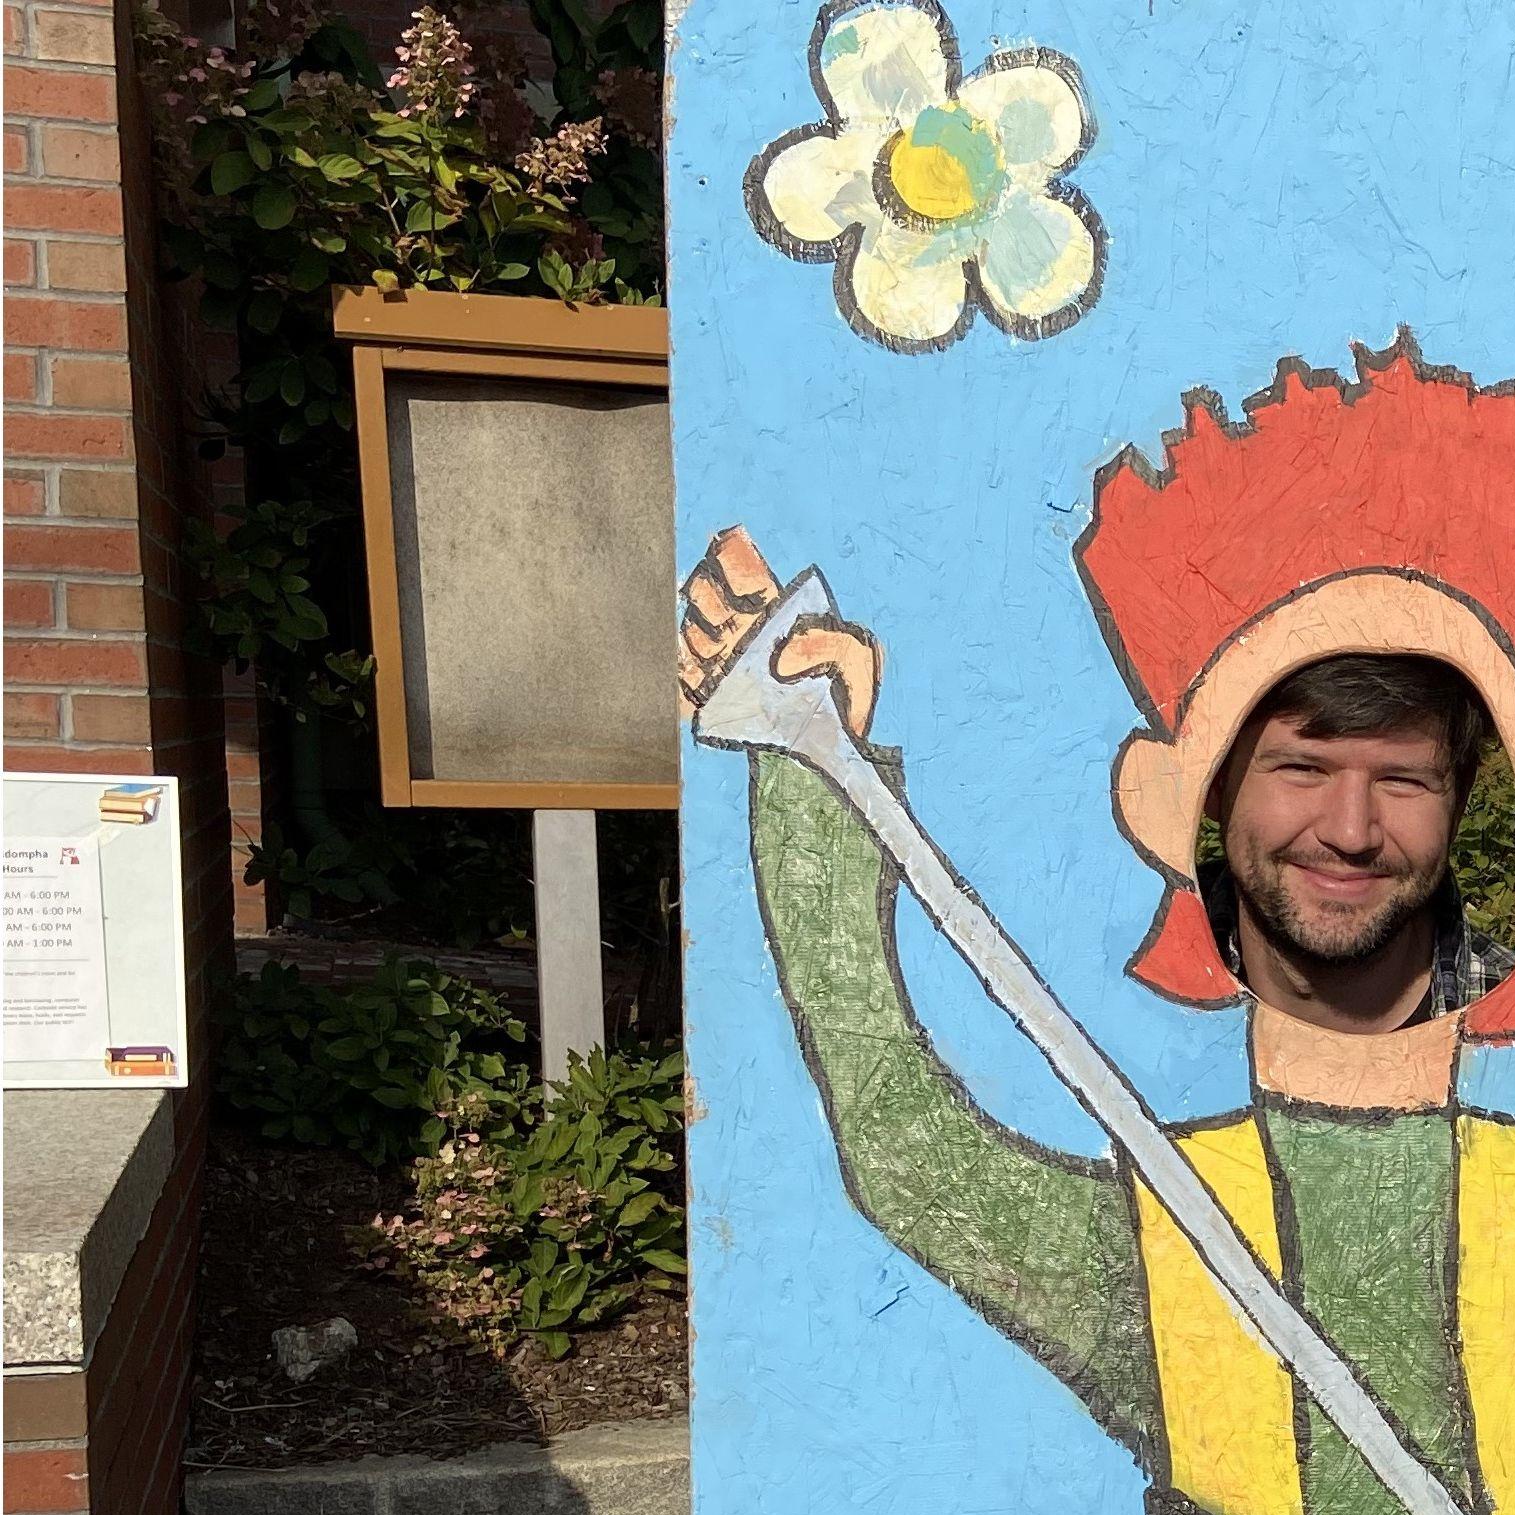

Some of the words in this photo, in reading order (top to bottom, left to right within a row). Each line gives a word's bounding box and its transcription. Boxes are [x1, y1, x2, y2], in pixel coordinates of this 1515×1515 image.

[3, 849, 49, 860] dompha
[4, 891, 21, 899] AM
[54, 891, 70, 899] PM
[17, 907, 34, 915] AM
[66, 907, 82, 915] PM
[6, 923, 23, 931] AM
[56, 923, 72, 931] PM
[7, 939, 24, 947] AM
[57, 939, 73, 947] PM
